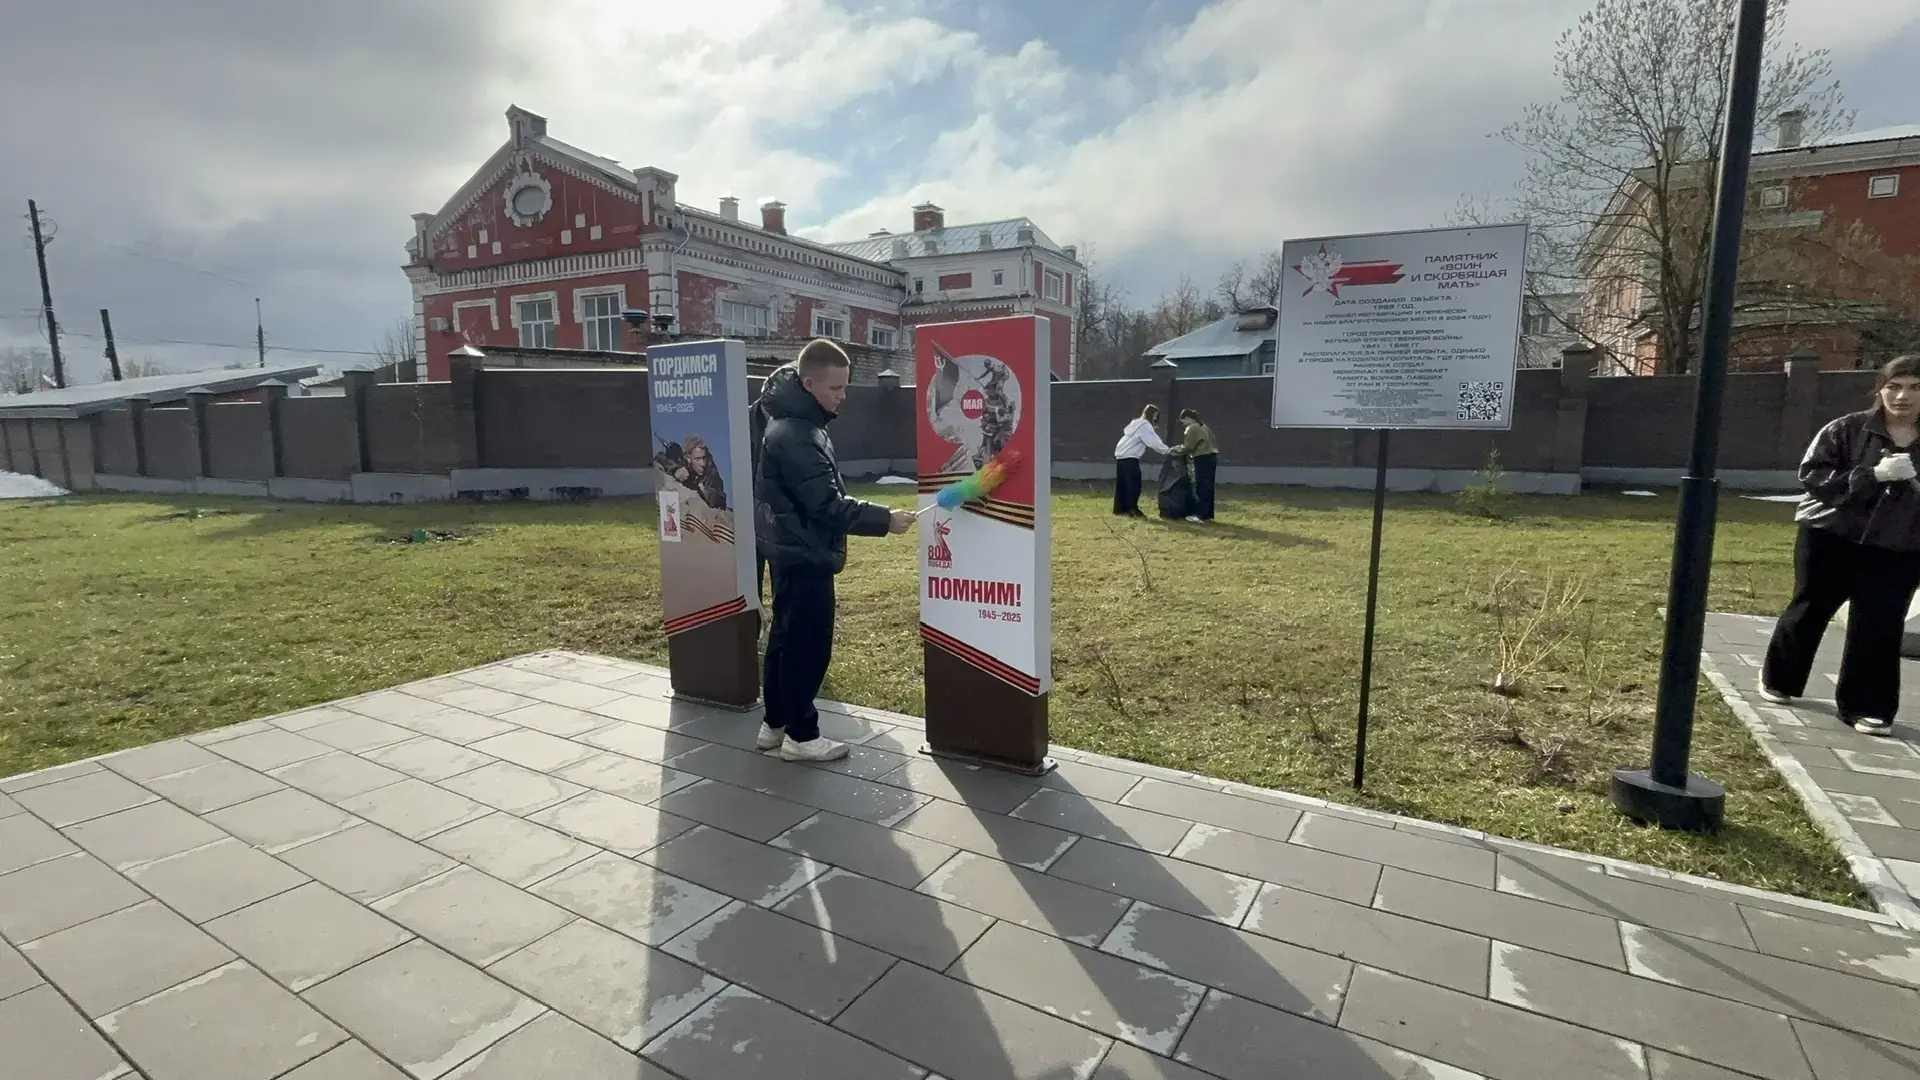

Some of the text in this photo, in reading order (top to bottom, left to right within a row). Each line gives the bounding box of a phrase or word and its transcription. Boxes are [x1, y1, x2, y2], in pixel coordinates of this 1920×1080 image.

[1424, 252, 1499, 263] ПАМЯТНИК
[1440, 262, 1482, 270] «ВОИН
[1411, 269, 1508, 282] И СКОРБЯЩАЯ
[1438, 280, 1481, 289] МАТЬ»
[652, 354, 717, 378] ГОРДИМСЯ
[654, 376, 713, 400] ПОБЕДОЙ!
[963, 398, 983, 410] МАЯ
[928, 576, 1021, 607] ПОМНИМ!
